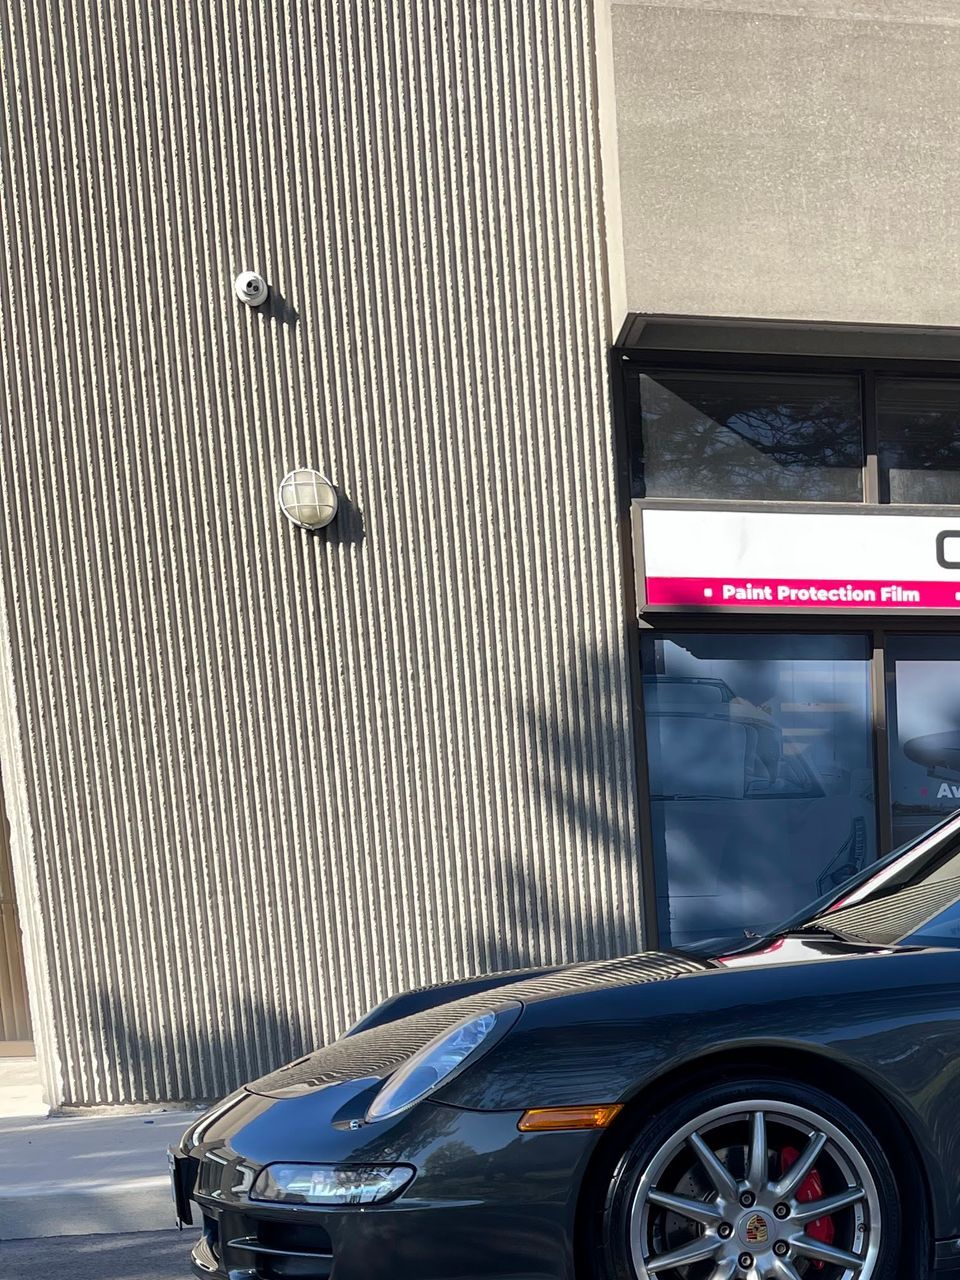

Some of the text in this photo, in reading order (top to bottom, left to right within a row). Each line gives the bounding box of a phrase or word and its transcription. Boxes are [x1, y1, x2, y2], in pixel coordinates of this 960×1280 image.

[722, 584, 920, 604] Paint Protection Film
